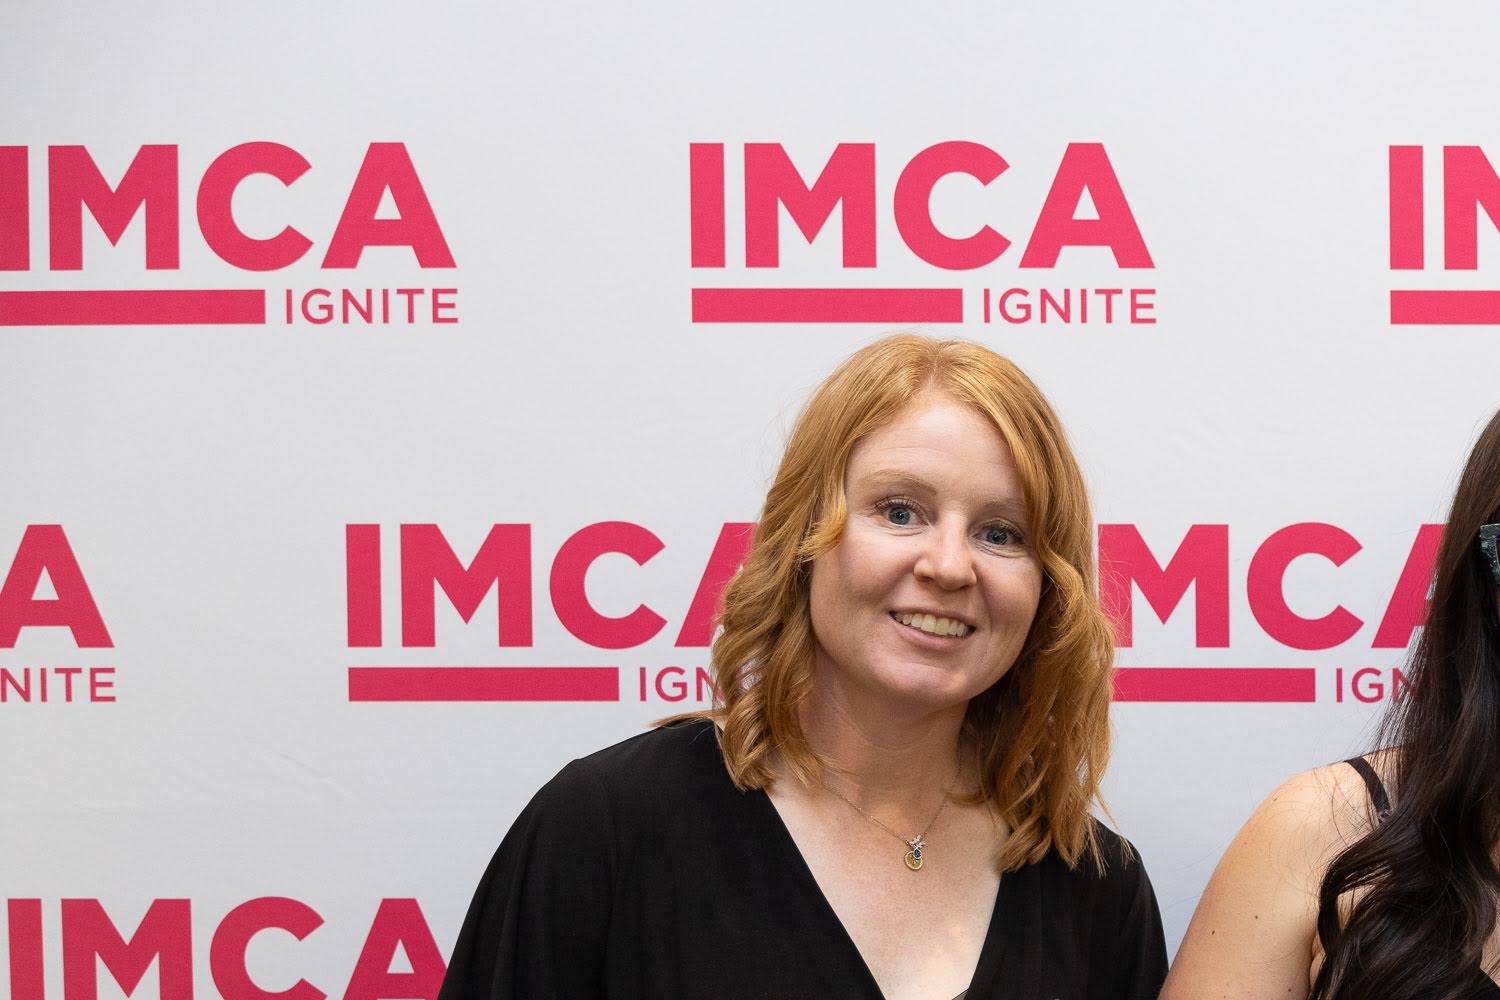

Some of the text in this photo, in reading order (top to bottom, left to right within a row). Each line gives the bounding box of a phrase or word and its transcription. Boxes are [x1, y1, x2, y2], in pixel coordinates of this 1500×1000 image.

[0, 142, 457, 272] IMCA
[690, 141, 1155, 270] IMCA
[286, 288, 458, 325] IGNITE
[984, 288, 1156, 324] IGNITE
[0, 667, 116, 702] NITE
[640, 667, 726, 702] IGN
[1336, 668, 1420, 703] IGN
